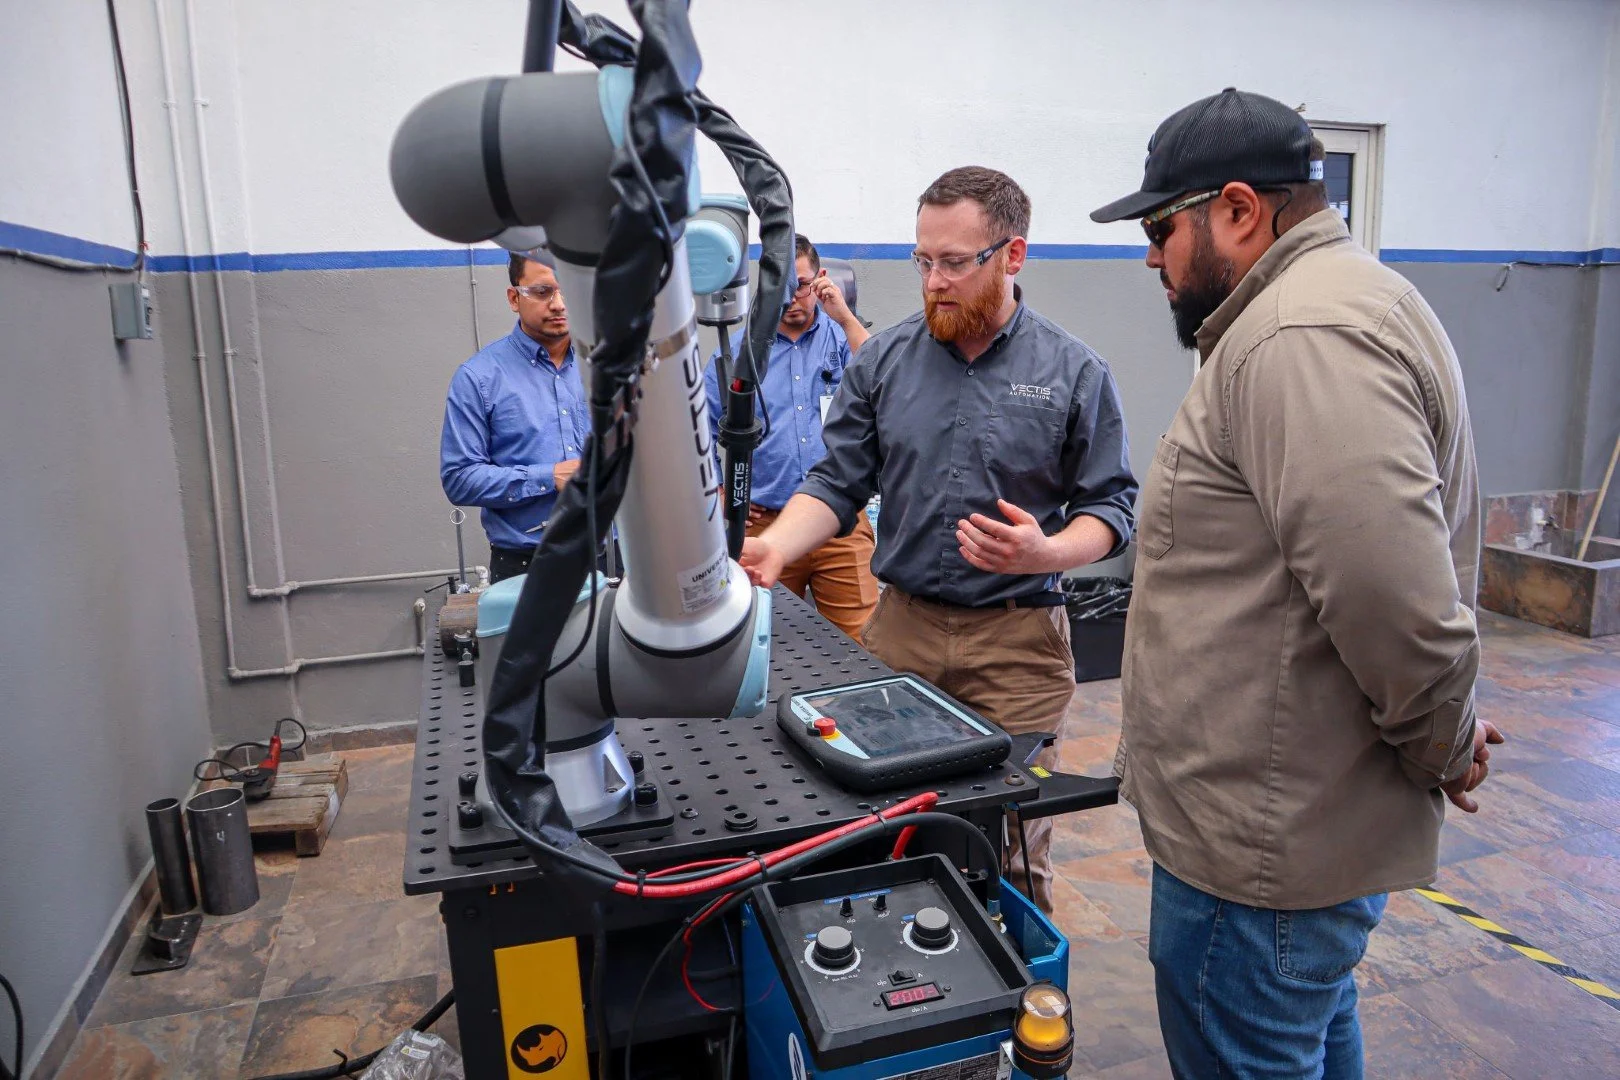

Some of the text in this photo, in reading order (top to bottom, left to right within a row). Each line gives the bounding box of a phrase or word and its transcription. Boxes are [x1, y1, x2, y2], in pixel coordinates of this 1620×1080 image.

[1009, 391, 1050, 400] AUTOMATION
[1010, 383, 1051, 396] VECTIS
[733, 462, 745, 507] VECTIS
